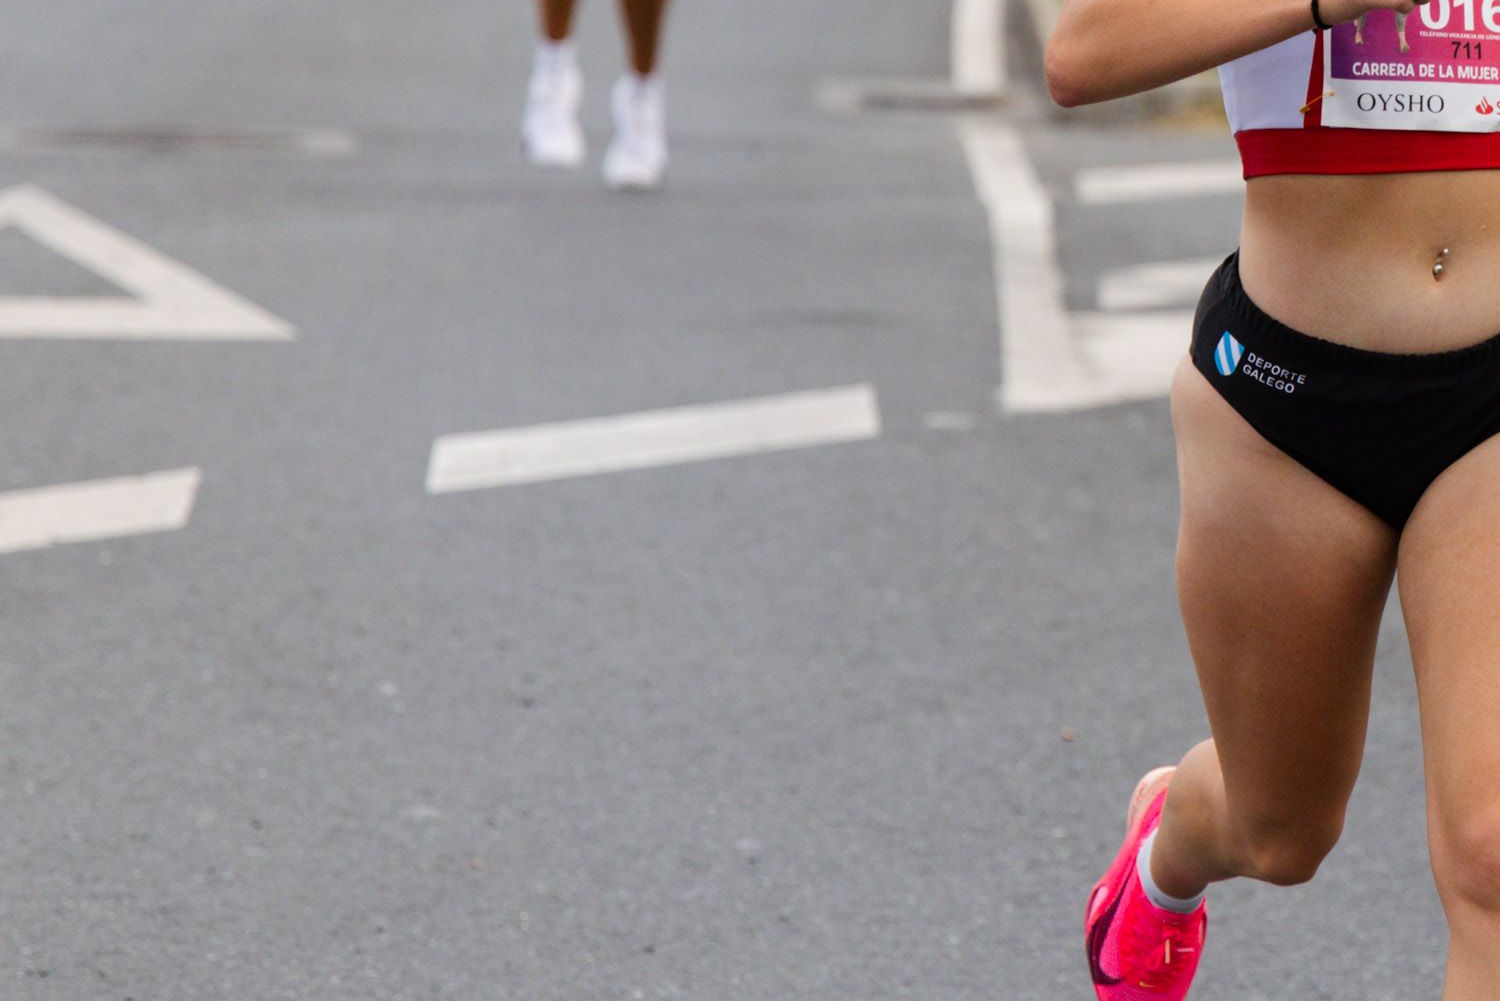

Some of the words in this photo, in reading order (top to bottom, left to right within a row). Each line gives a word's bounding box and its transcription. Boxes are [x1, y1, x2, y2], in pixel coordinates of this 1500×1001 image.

[1451, 41, 1482, 59] 711
[1352, 61, 1415, 77] CARRERA
[1419, 64, 1435, 78] DE
[1439, 64, 1454, 79] LA
[1457, 65, 1499, 81] MUJER
[1357, 92, 1445, 114] OYSHO
[1242, 364, 1295, 393] GALEGO
[1247, 352, 1306, 384] DEPORTE
